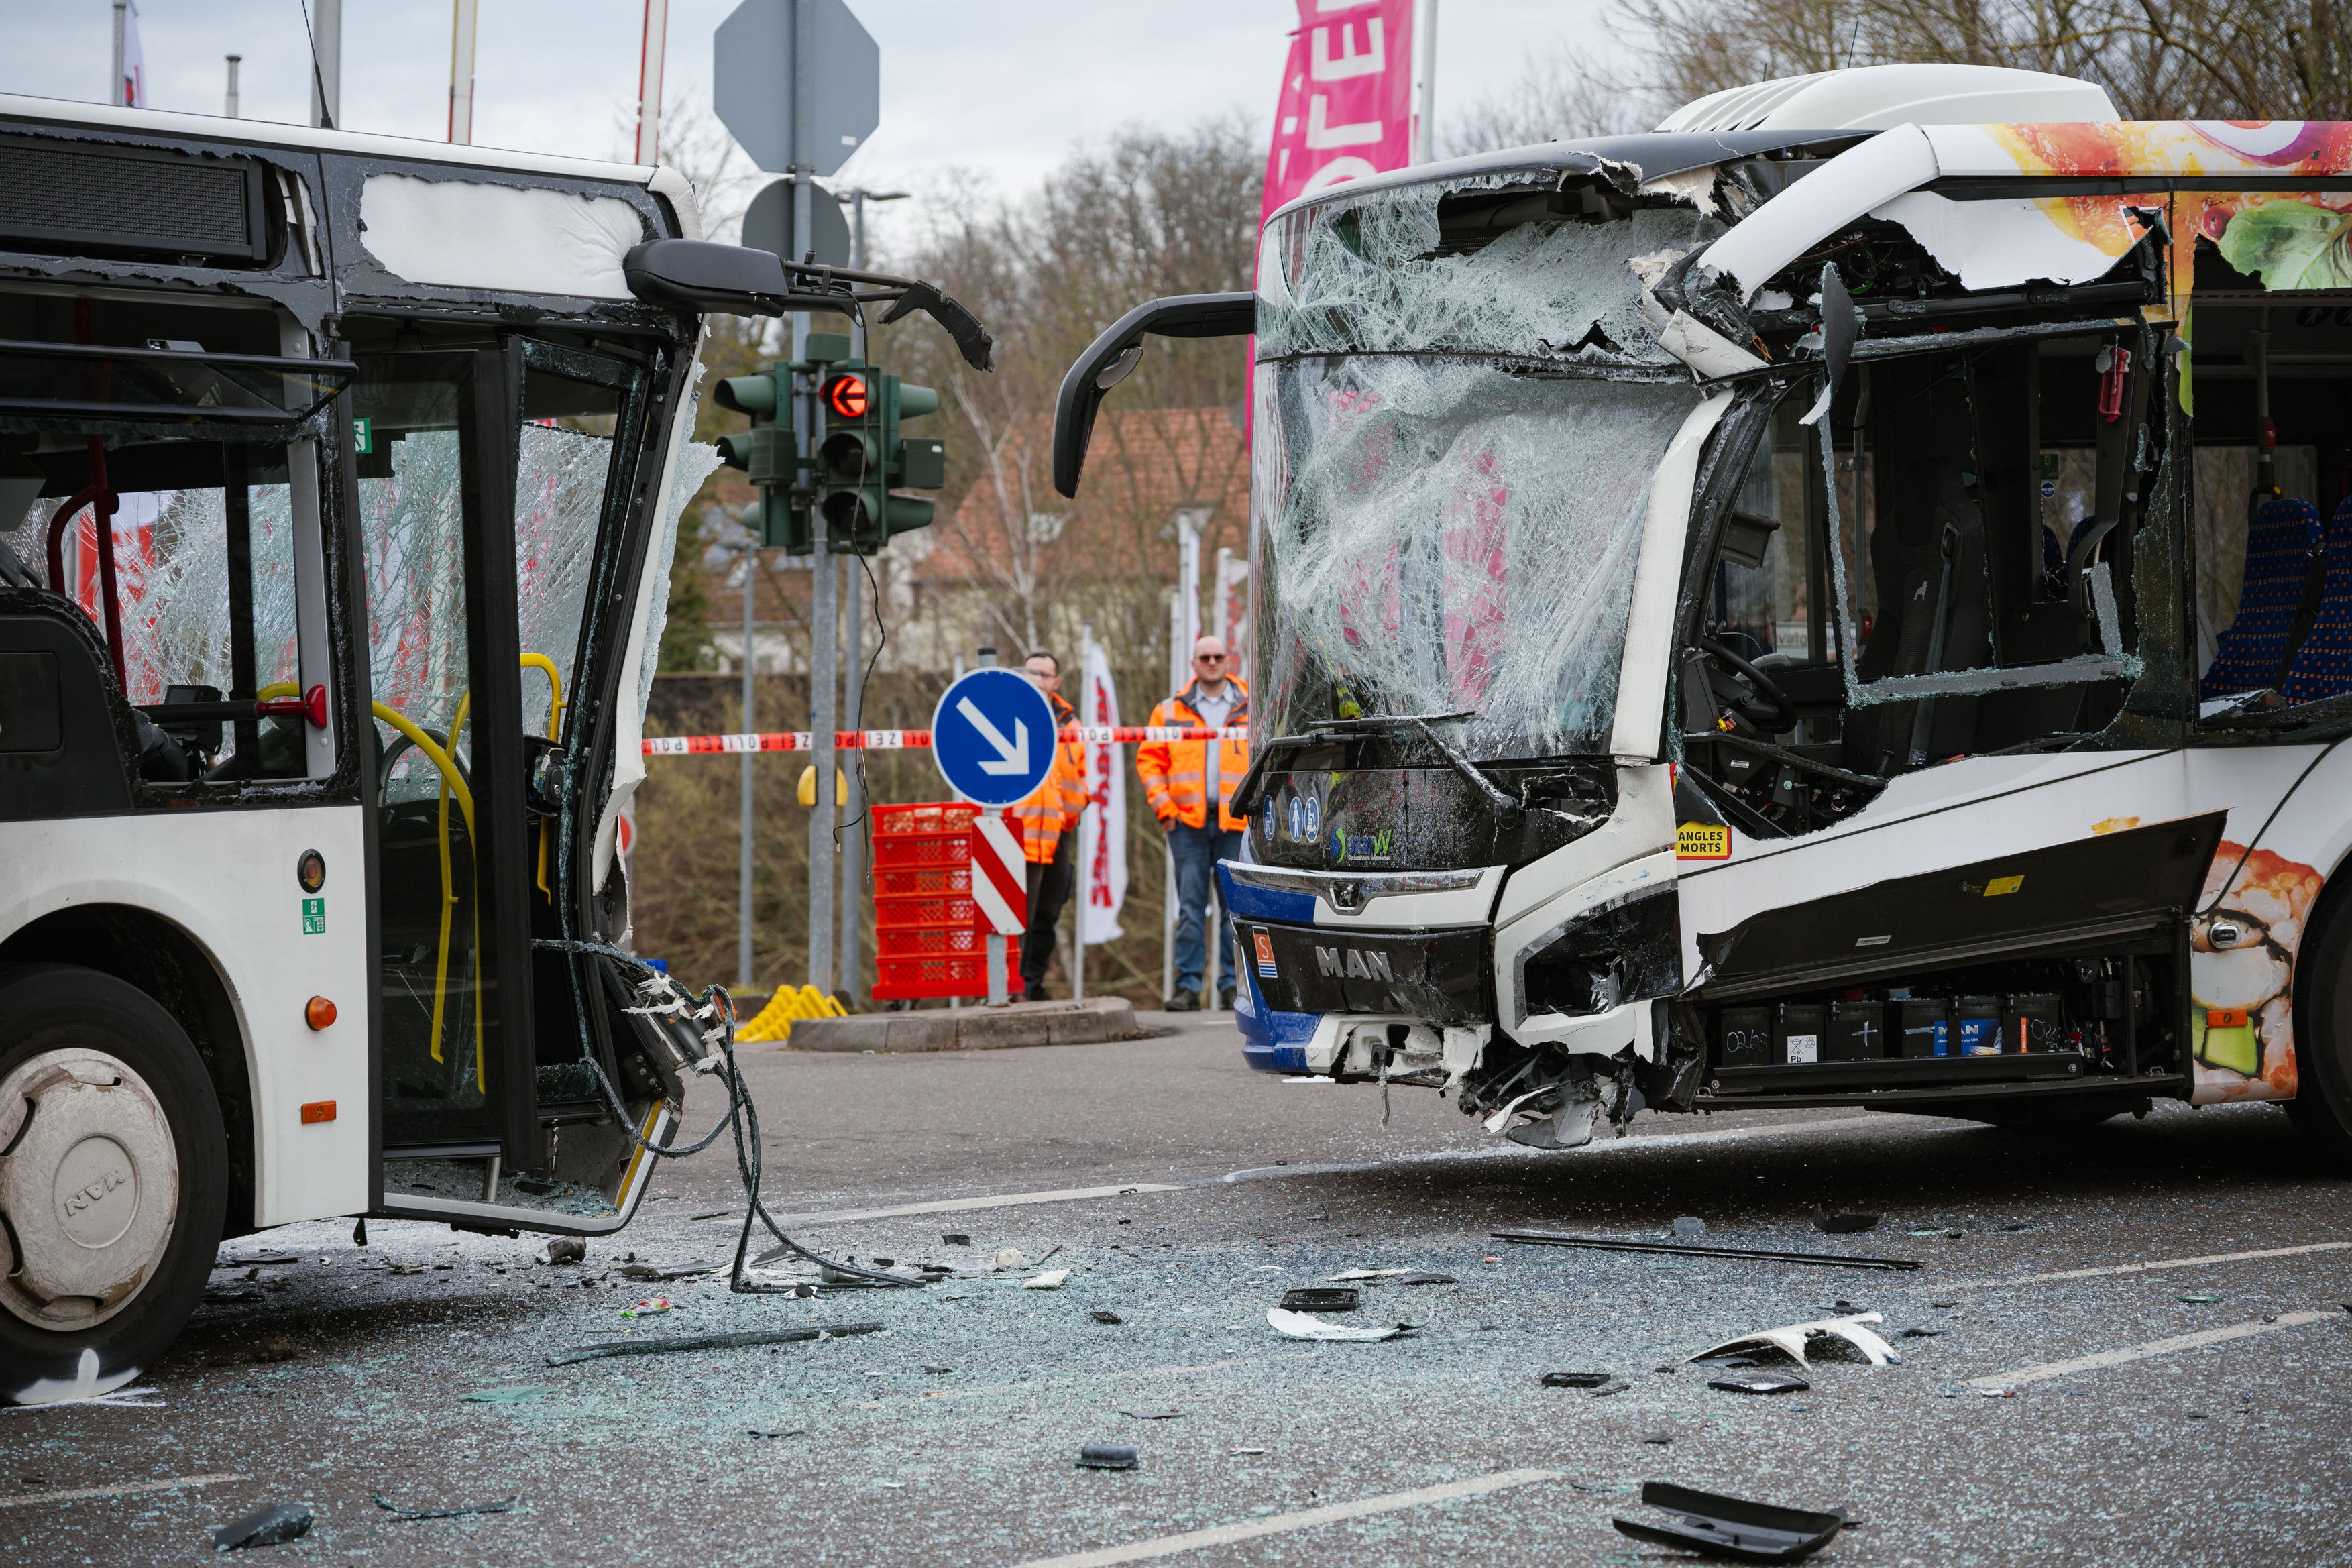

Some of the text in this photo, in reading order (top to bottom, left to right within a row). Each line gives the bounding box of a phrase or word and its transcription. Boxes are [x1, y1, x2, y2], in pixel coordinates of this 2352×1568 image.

[641, 740, 683, 753] POLI
[1090, 677, 1113, 907] Saarbaar
[1678, 832, 1723, 841] ANGLES
[1681, 843, 1721, 852] MORTS
[1259, 936, 1270, 959] S
[1315, 946, 1395, 983] MAN
[64, 1166, 127, 1217] MAN
